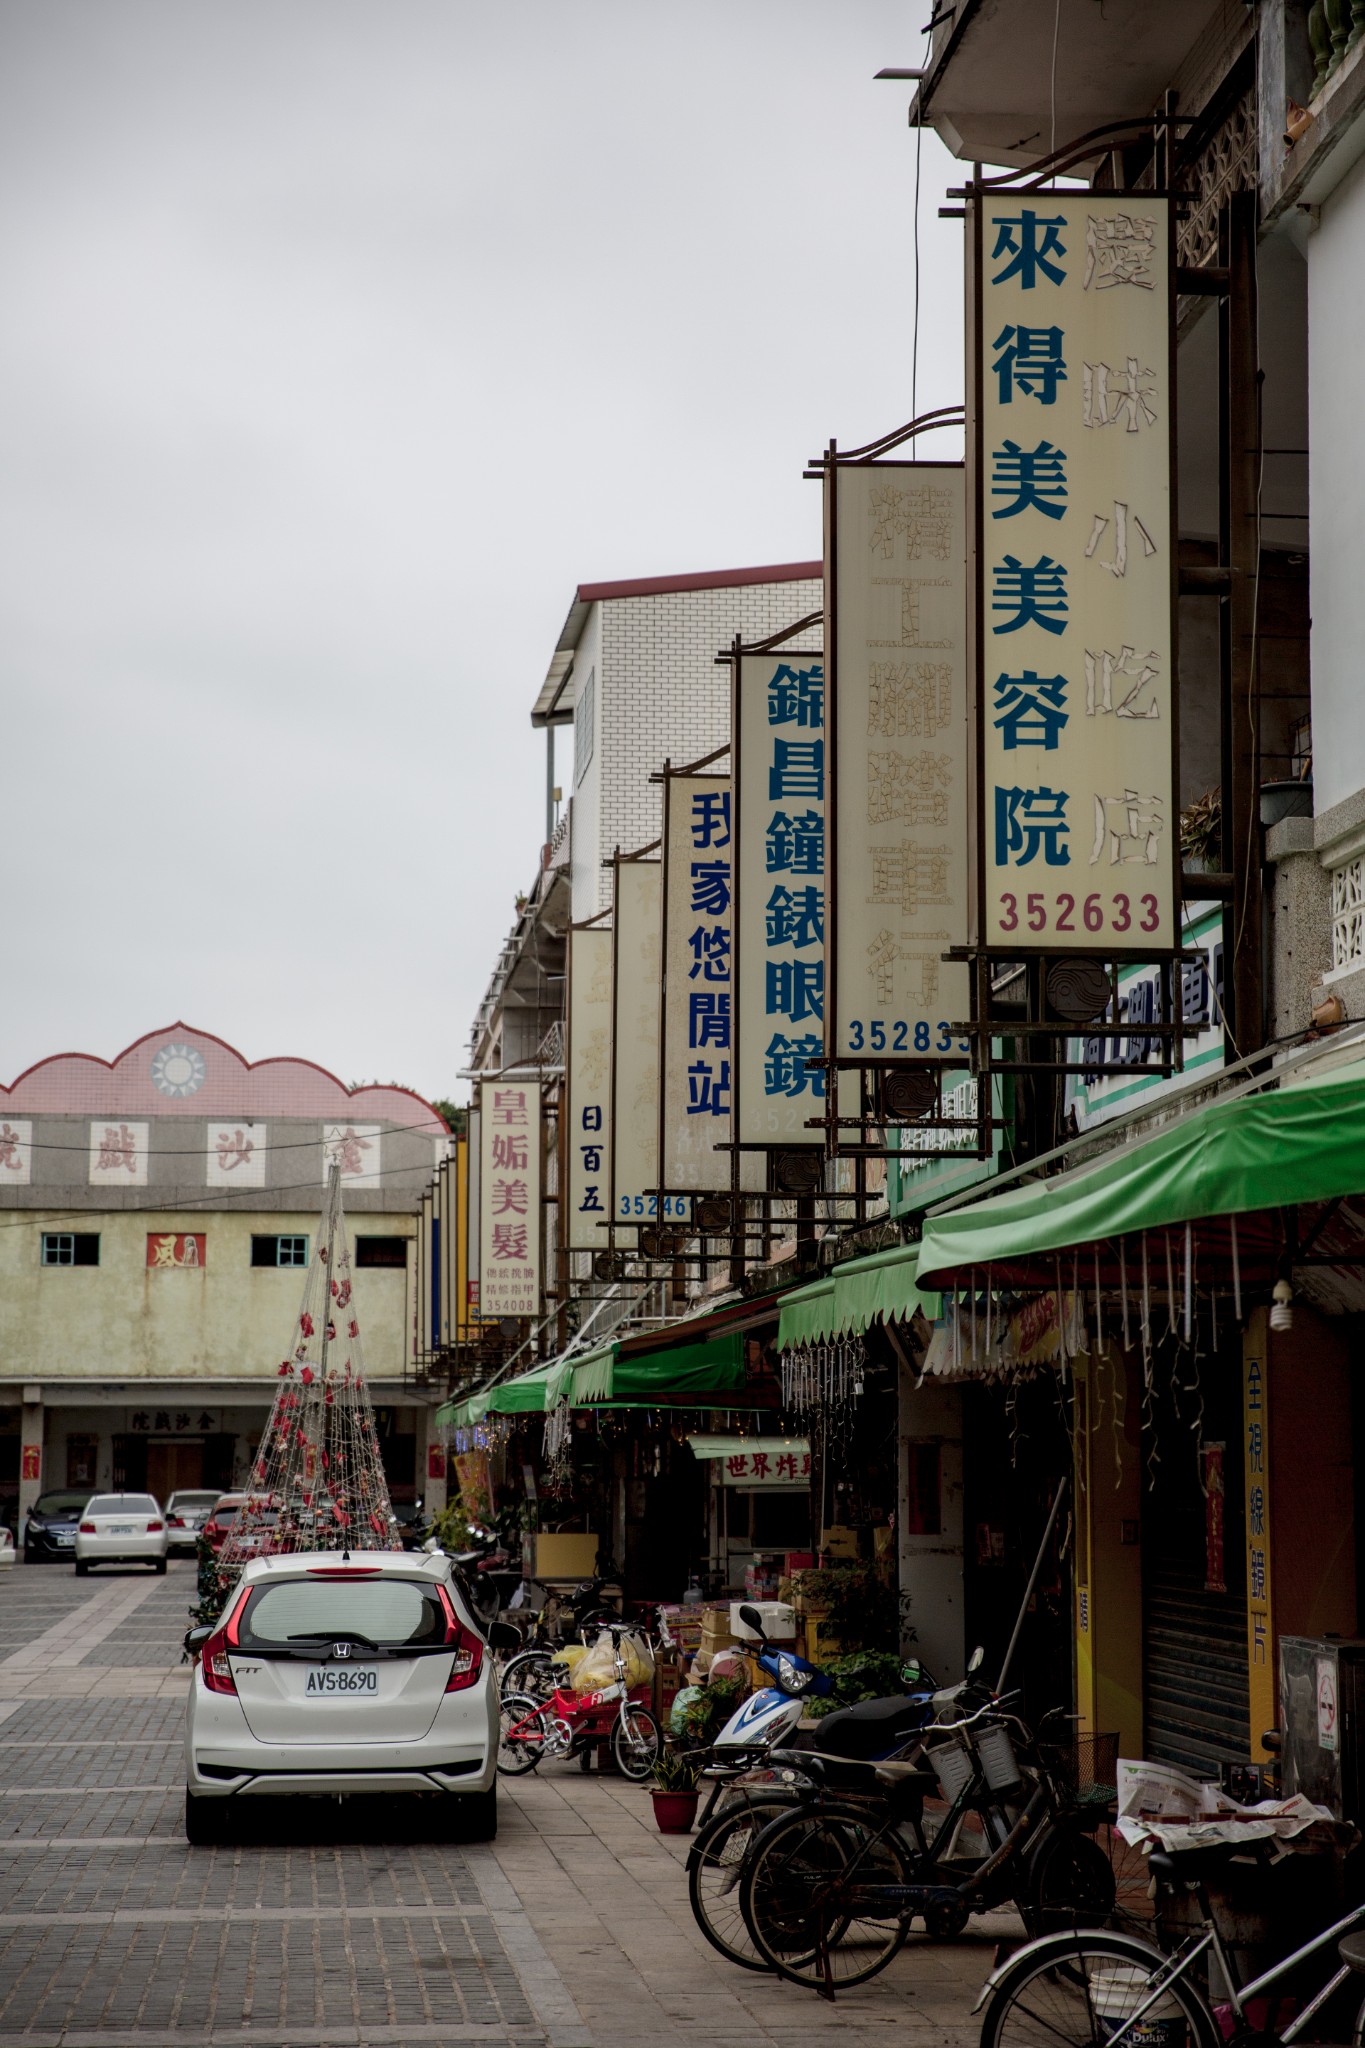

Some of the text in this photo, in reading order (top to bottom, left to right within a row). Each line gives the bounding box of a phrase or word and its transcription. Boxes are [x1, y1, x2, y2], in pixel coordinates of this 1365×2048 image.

[991, 210, 1071, 867] 來得美美容院
[686, 791, 730, 1117] 我家悠閒站
[999, 893, 1161, 932] 352633
[578, 1104, 605, 1213] 日百五
[487, 1299, 533, 1312] 354008
[1247, 1360, 1267, 1665] 全視線鏡片
[1132, 2031, 1167, 2043] Dulux
